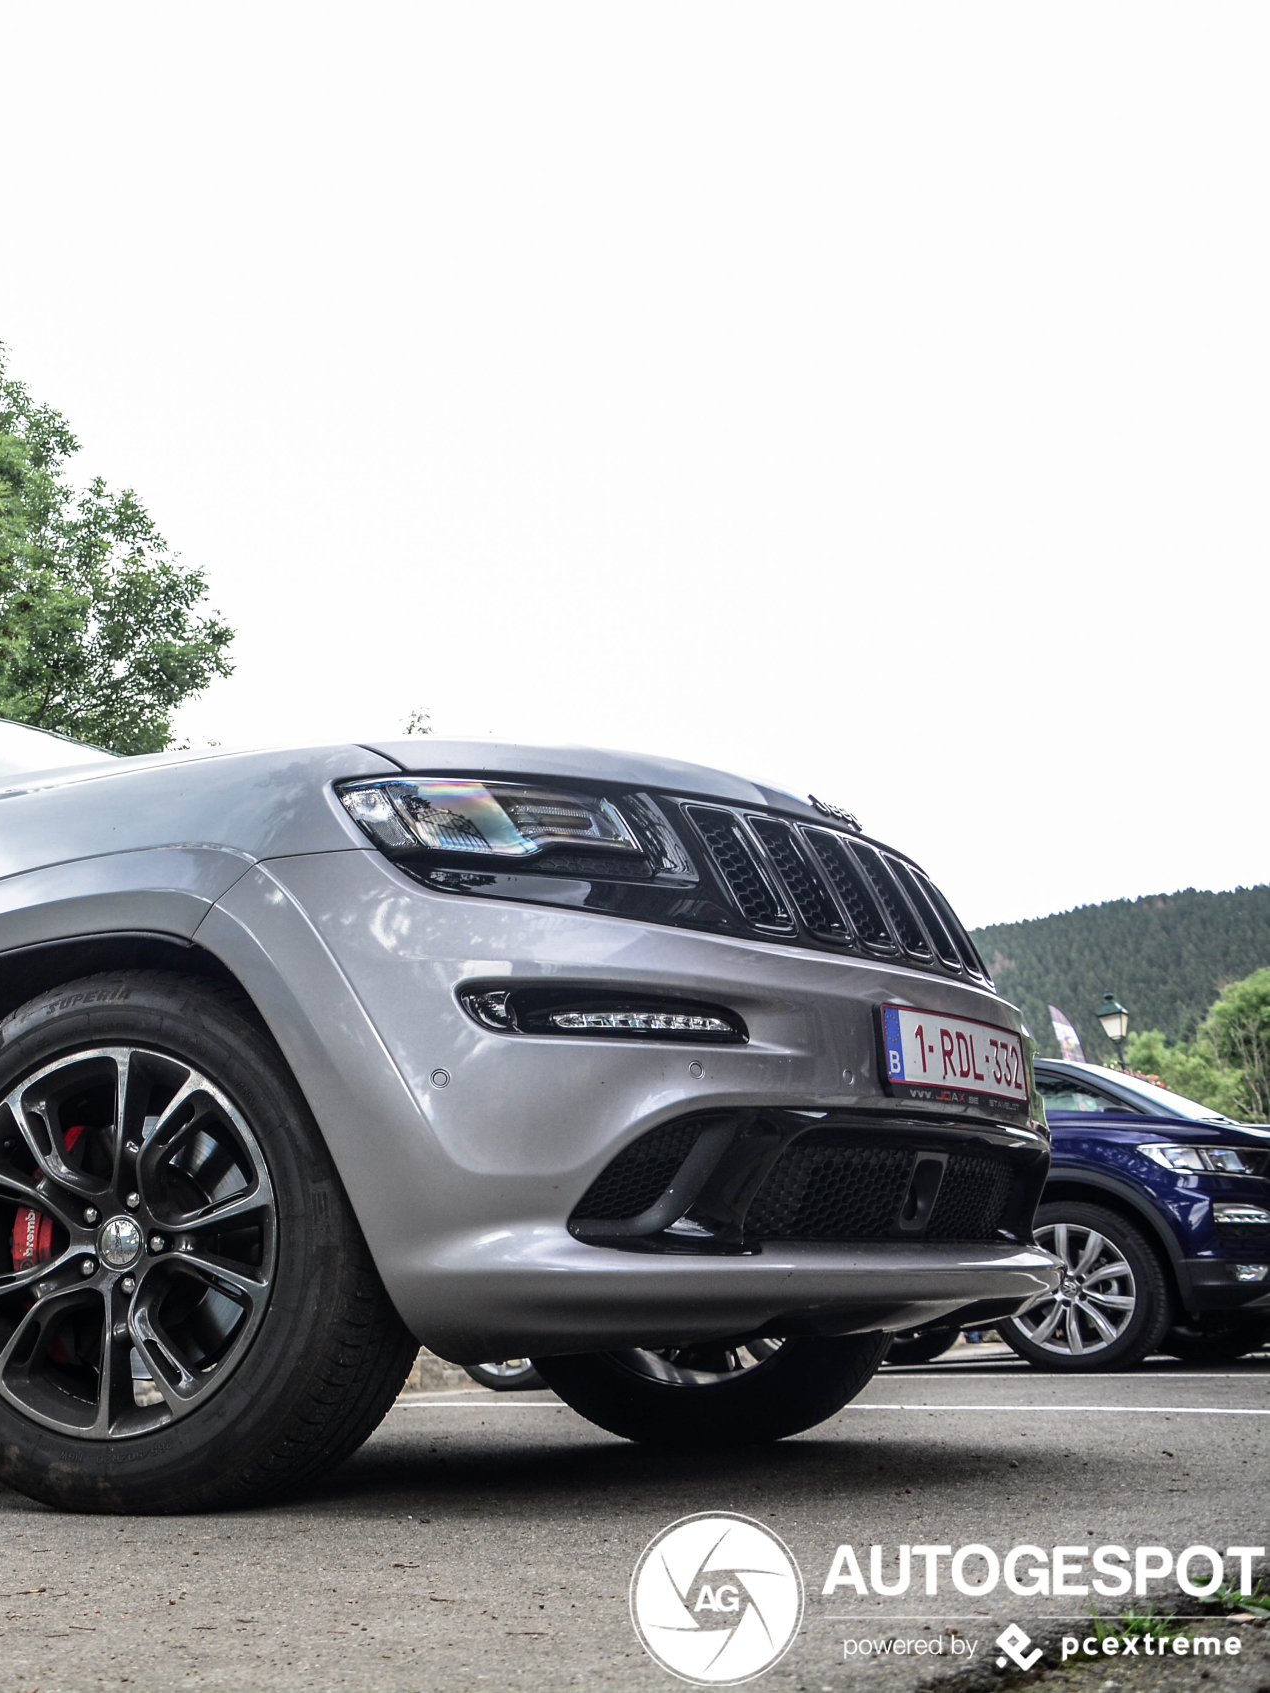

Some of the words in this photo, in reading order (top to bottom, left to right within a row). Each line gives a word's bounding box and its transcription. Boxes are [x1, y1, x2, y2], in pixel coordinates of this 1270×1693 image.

[889, 1050, 901, 1074] B
[914, 1024, 1023, 1090] 1-RDL-332
[23, 1208, 36, 1257] bremb
